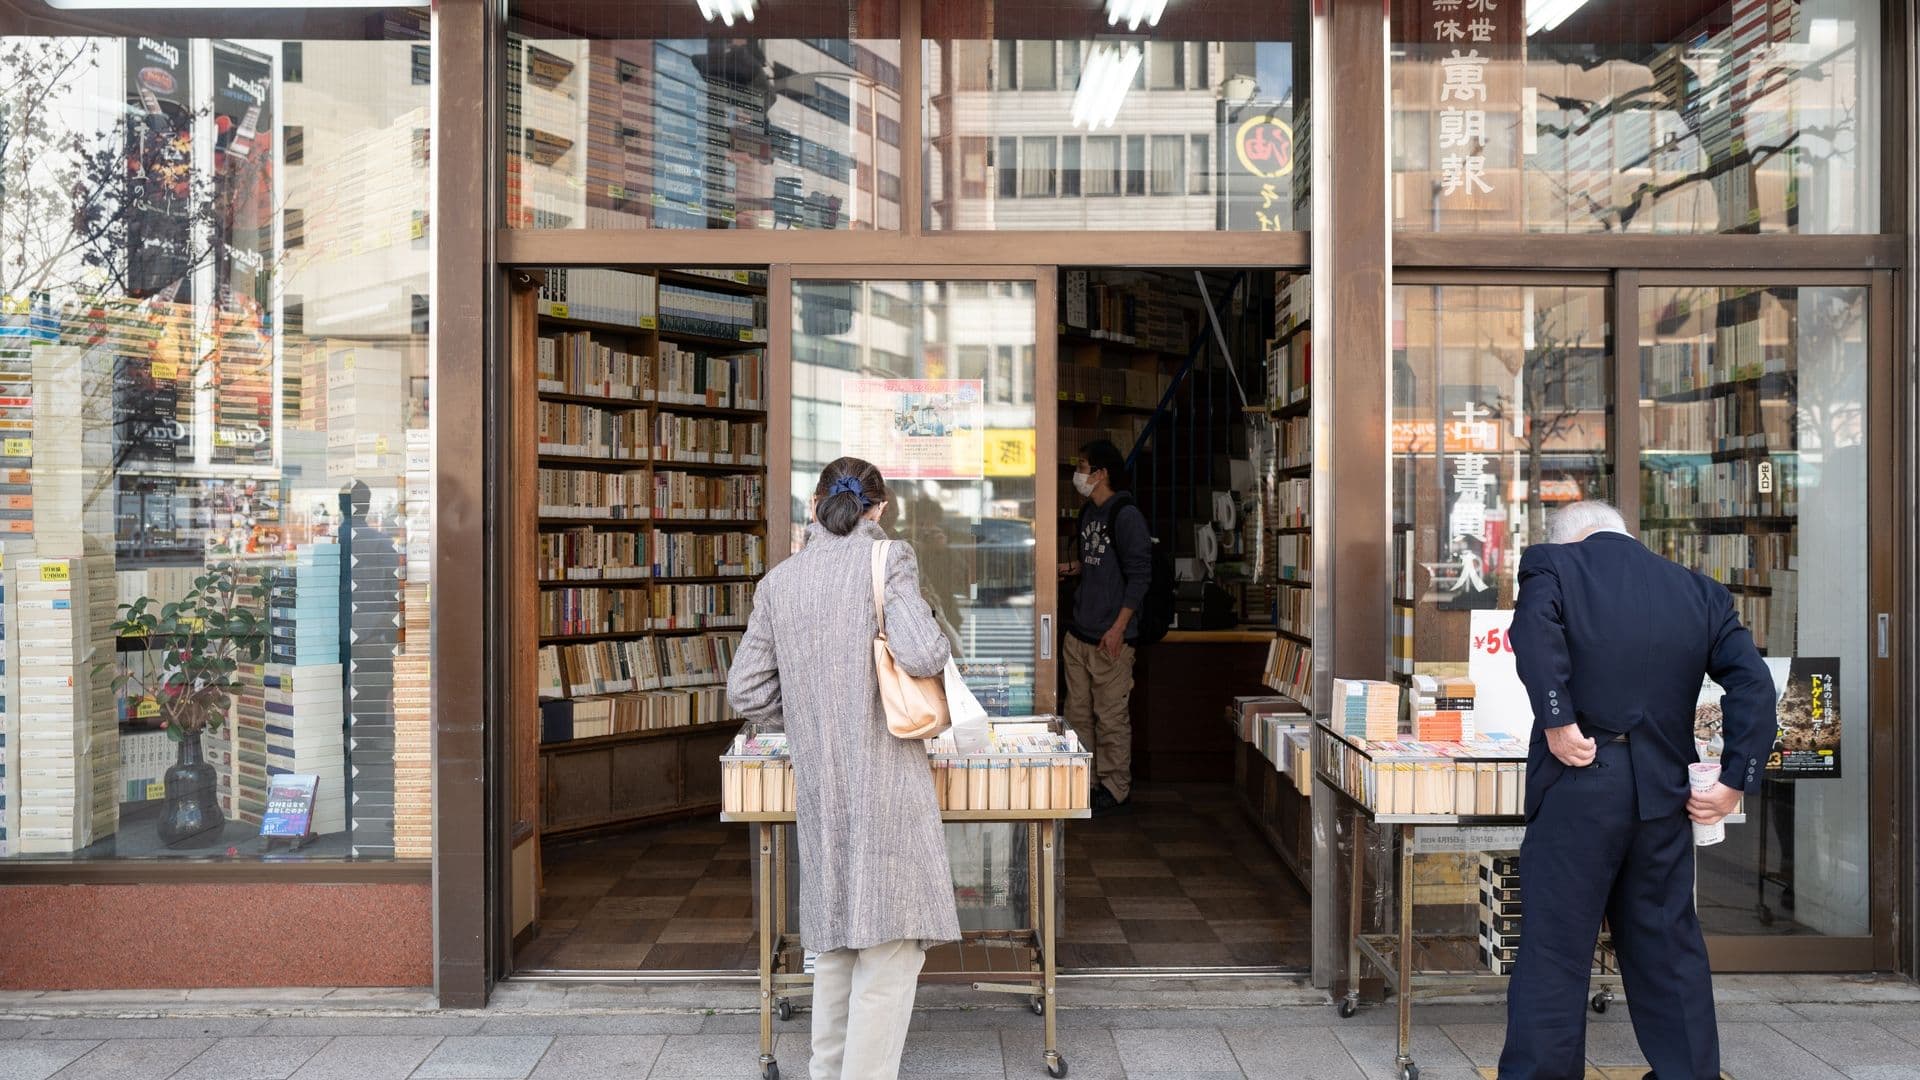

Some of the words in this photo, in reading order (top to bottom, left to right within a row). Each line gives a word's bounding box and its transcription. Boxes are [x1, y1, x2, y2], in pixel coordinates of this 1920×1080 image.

[1439, 49, 1494, 196] 萬朝報
[1761, 464, 1770, 489] 出入口
